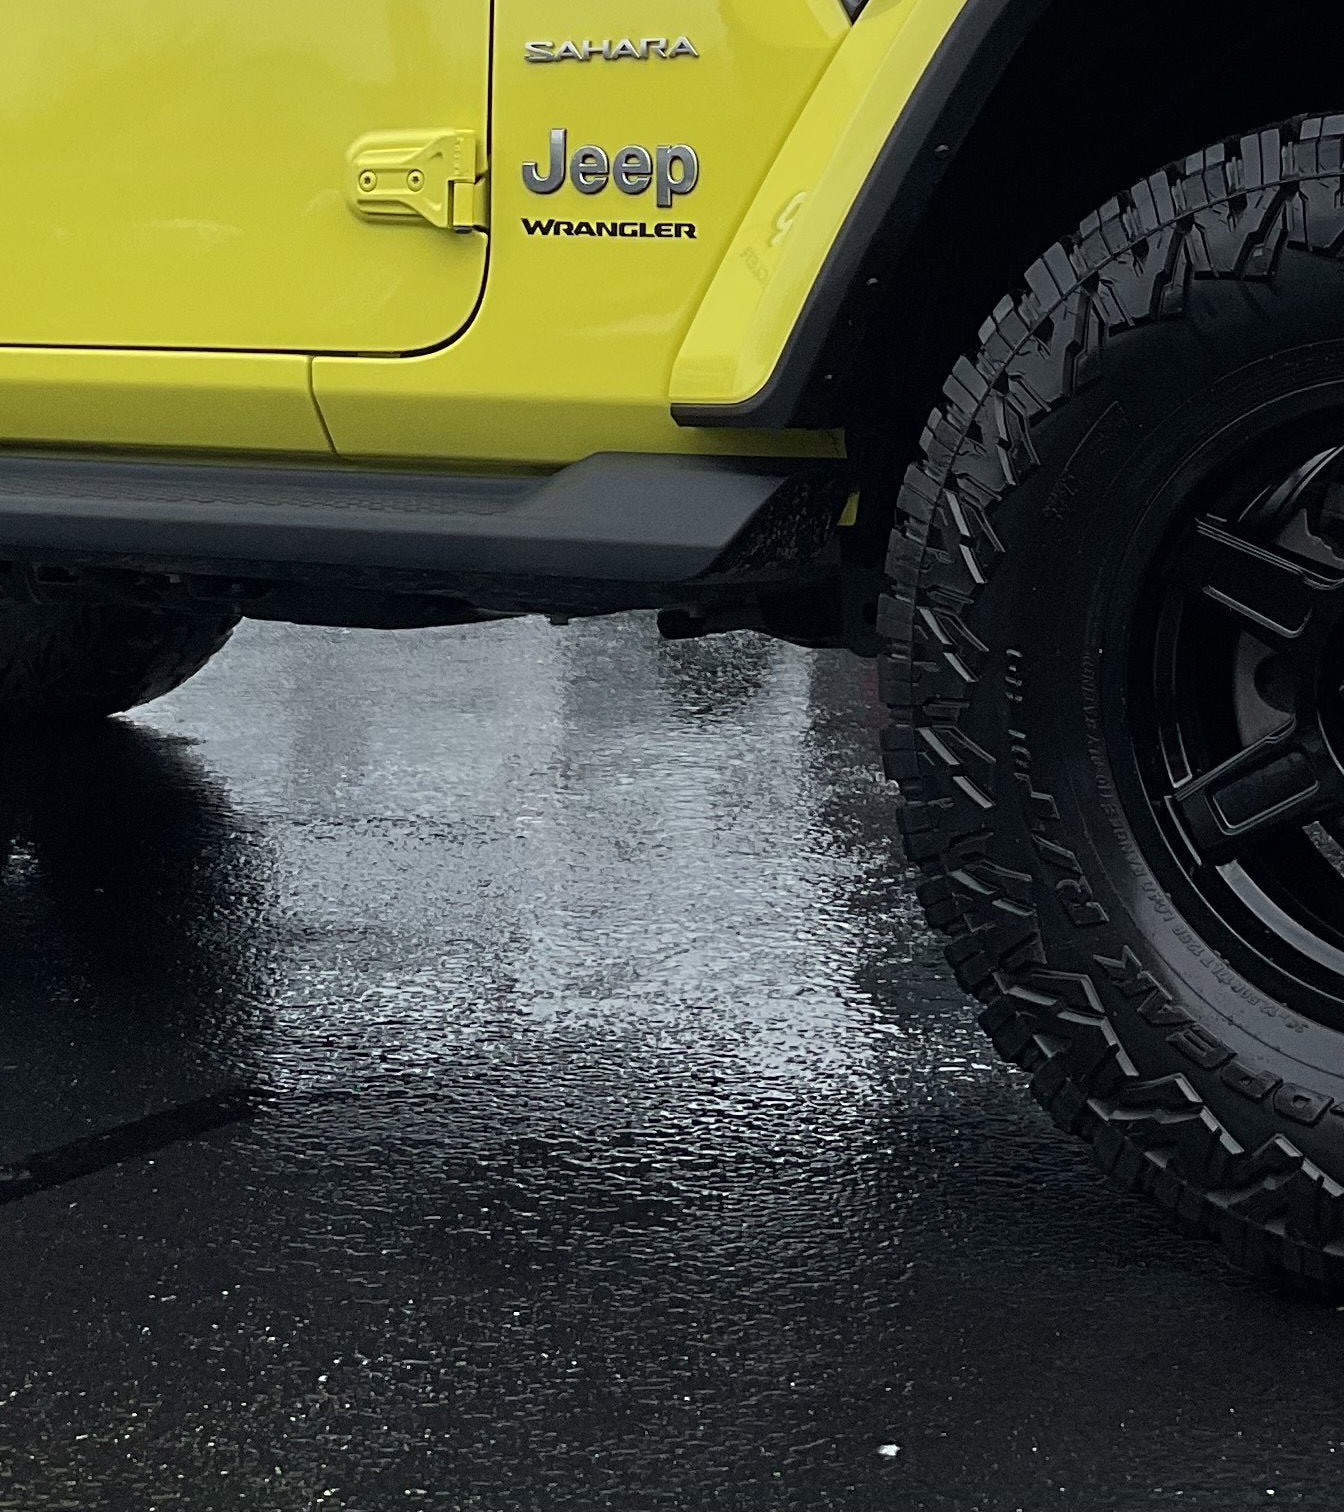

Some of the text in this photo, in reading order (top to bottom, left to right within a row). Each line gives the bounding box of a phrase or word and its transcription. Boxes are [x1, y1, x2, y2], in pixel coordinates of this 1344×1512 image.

[524, 36, 699, 63] SAHARA
[522, 128, 699, 208] Jeep
[521, 218, 697, 239] WRANGLER
